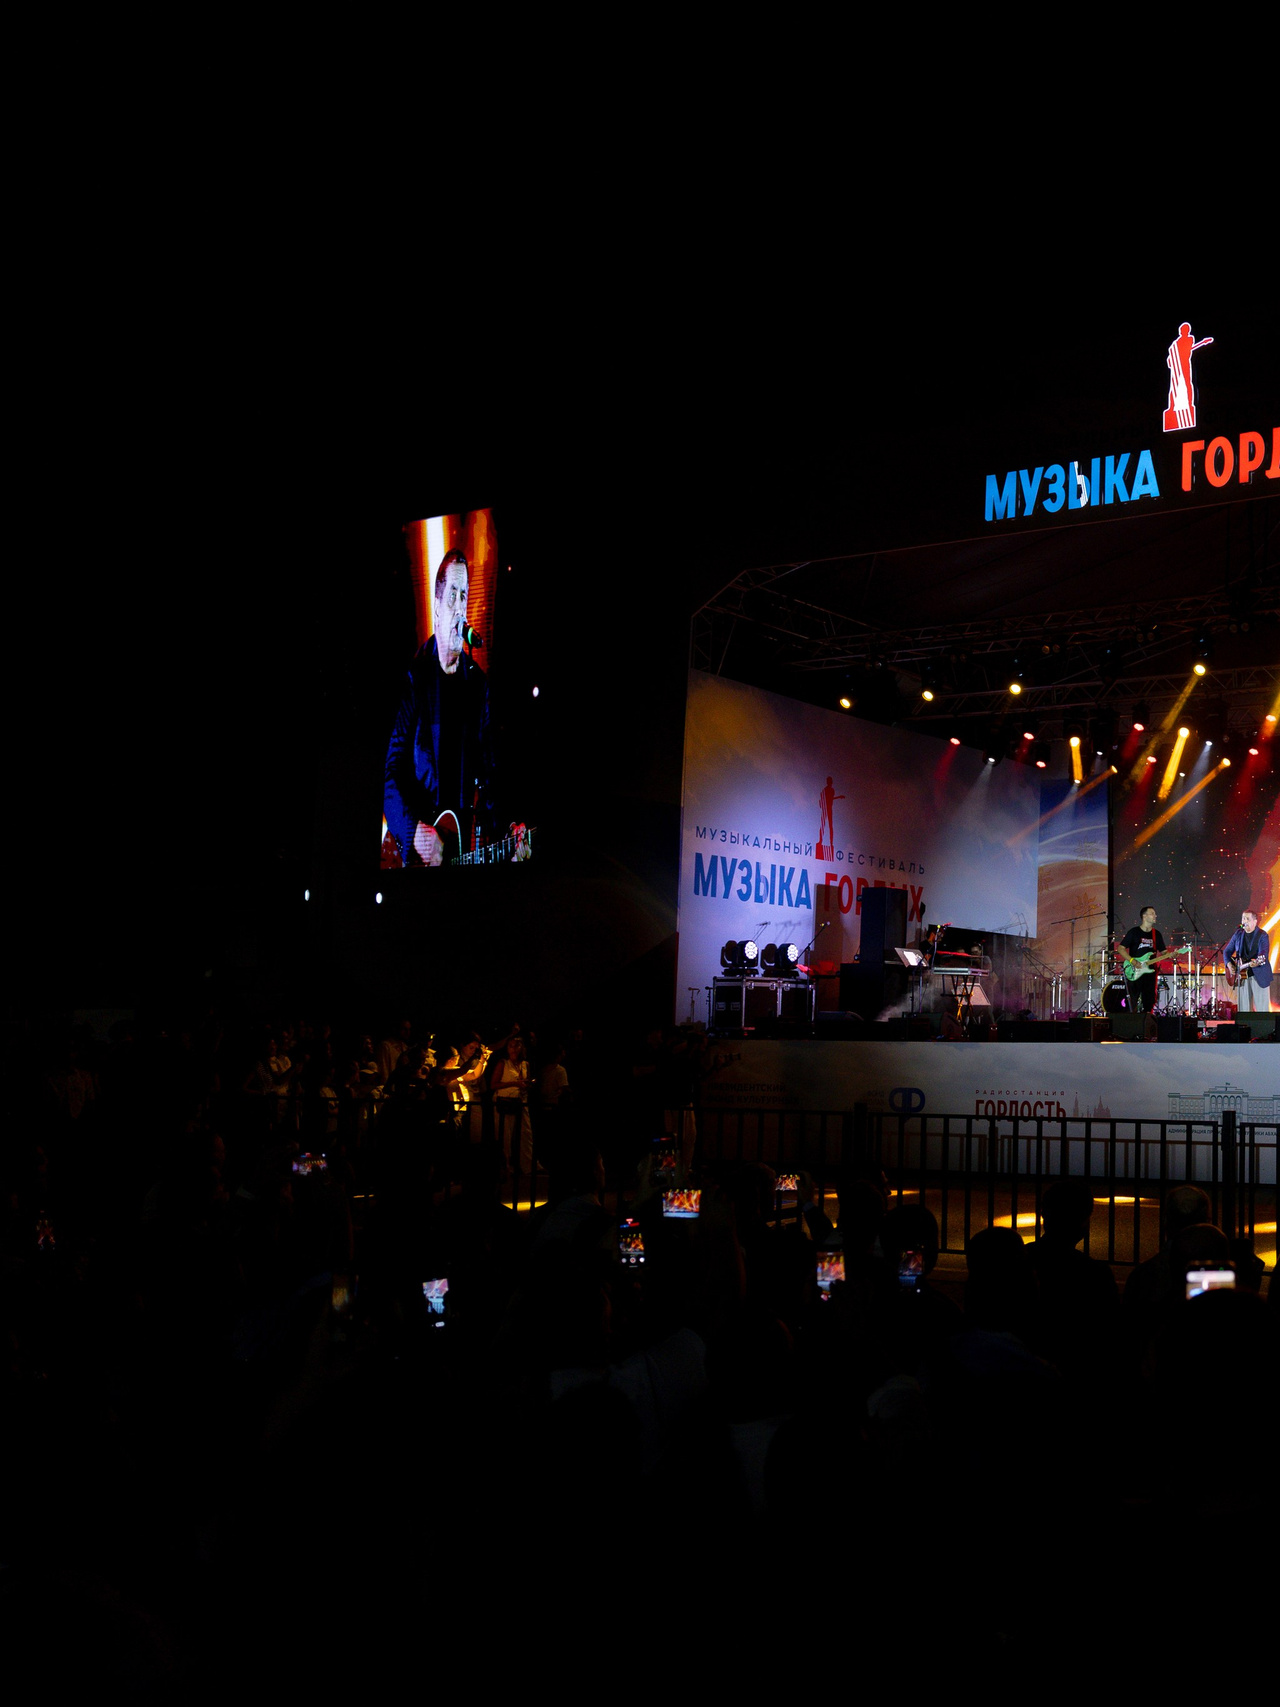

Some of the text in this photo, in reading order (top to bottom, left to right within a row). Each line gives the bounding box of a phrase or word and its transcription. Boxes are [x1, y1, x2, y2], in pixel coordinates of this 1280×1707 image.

[984, 449, 1161, 522] МУЗЫКА
[695, 825, 925, 875] МУЗЫКАЛЬНЫЙ ФЕСТИВАЛЬ
[693, 852, 812, 910] МУЗЫКА
[975, 1089, 1065, 1097] РАДИОСТАНЦИЯ
